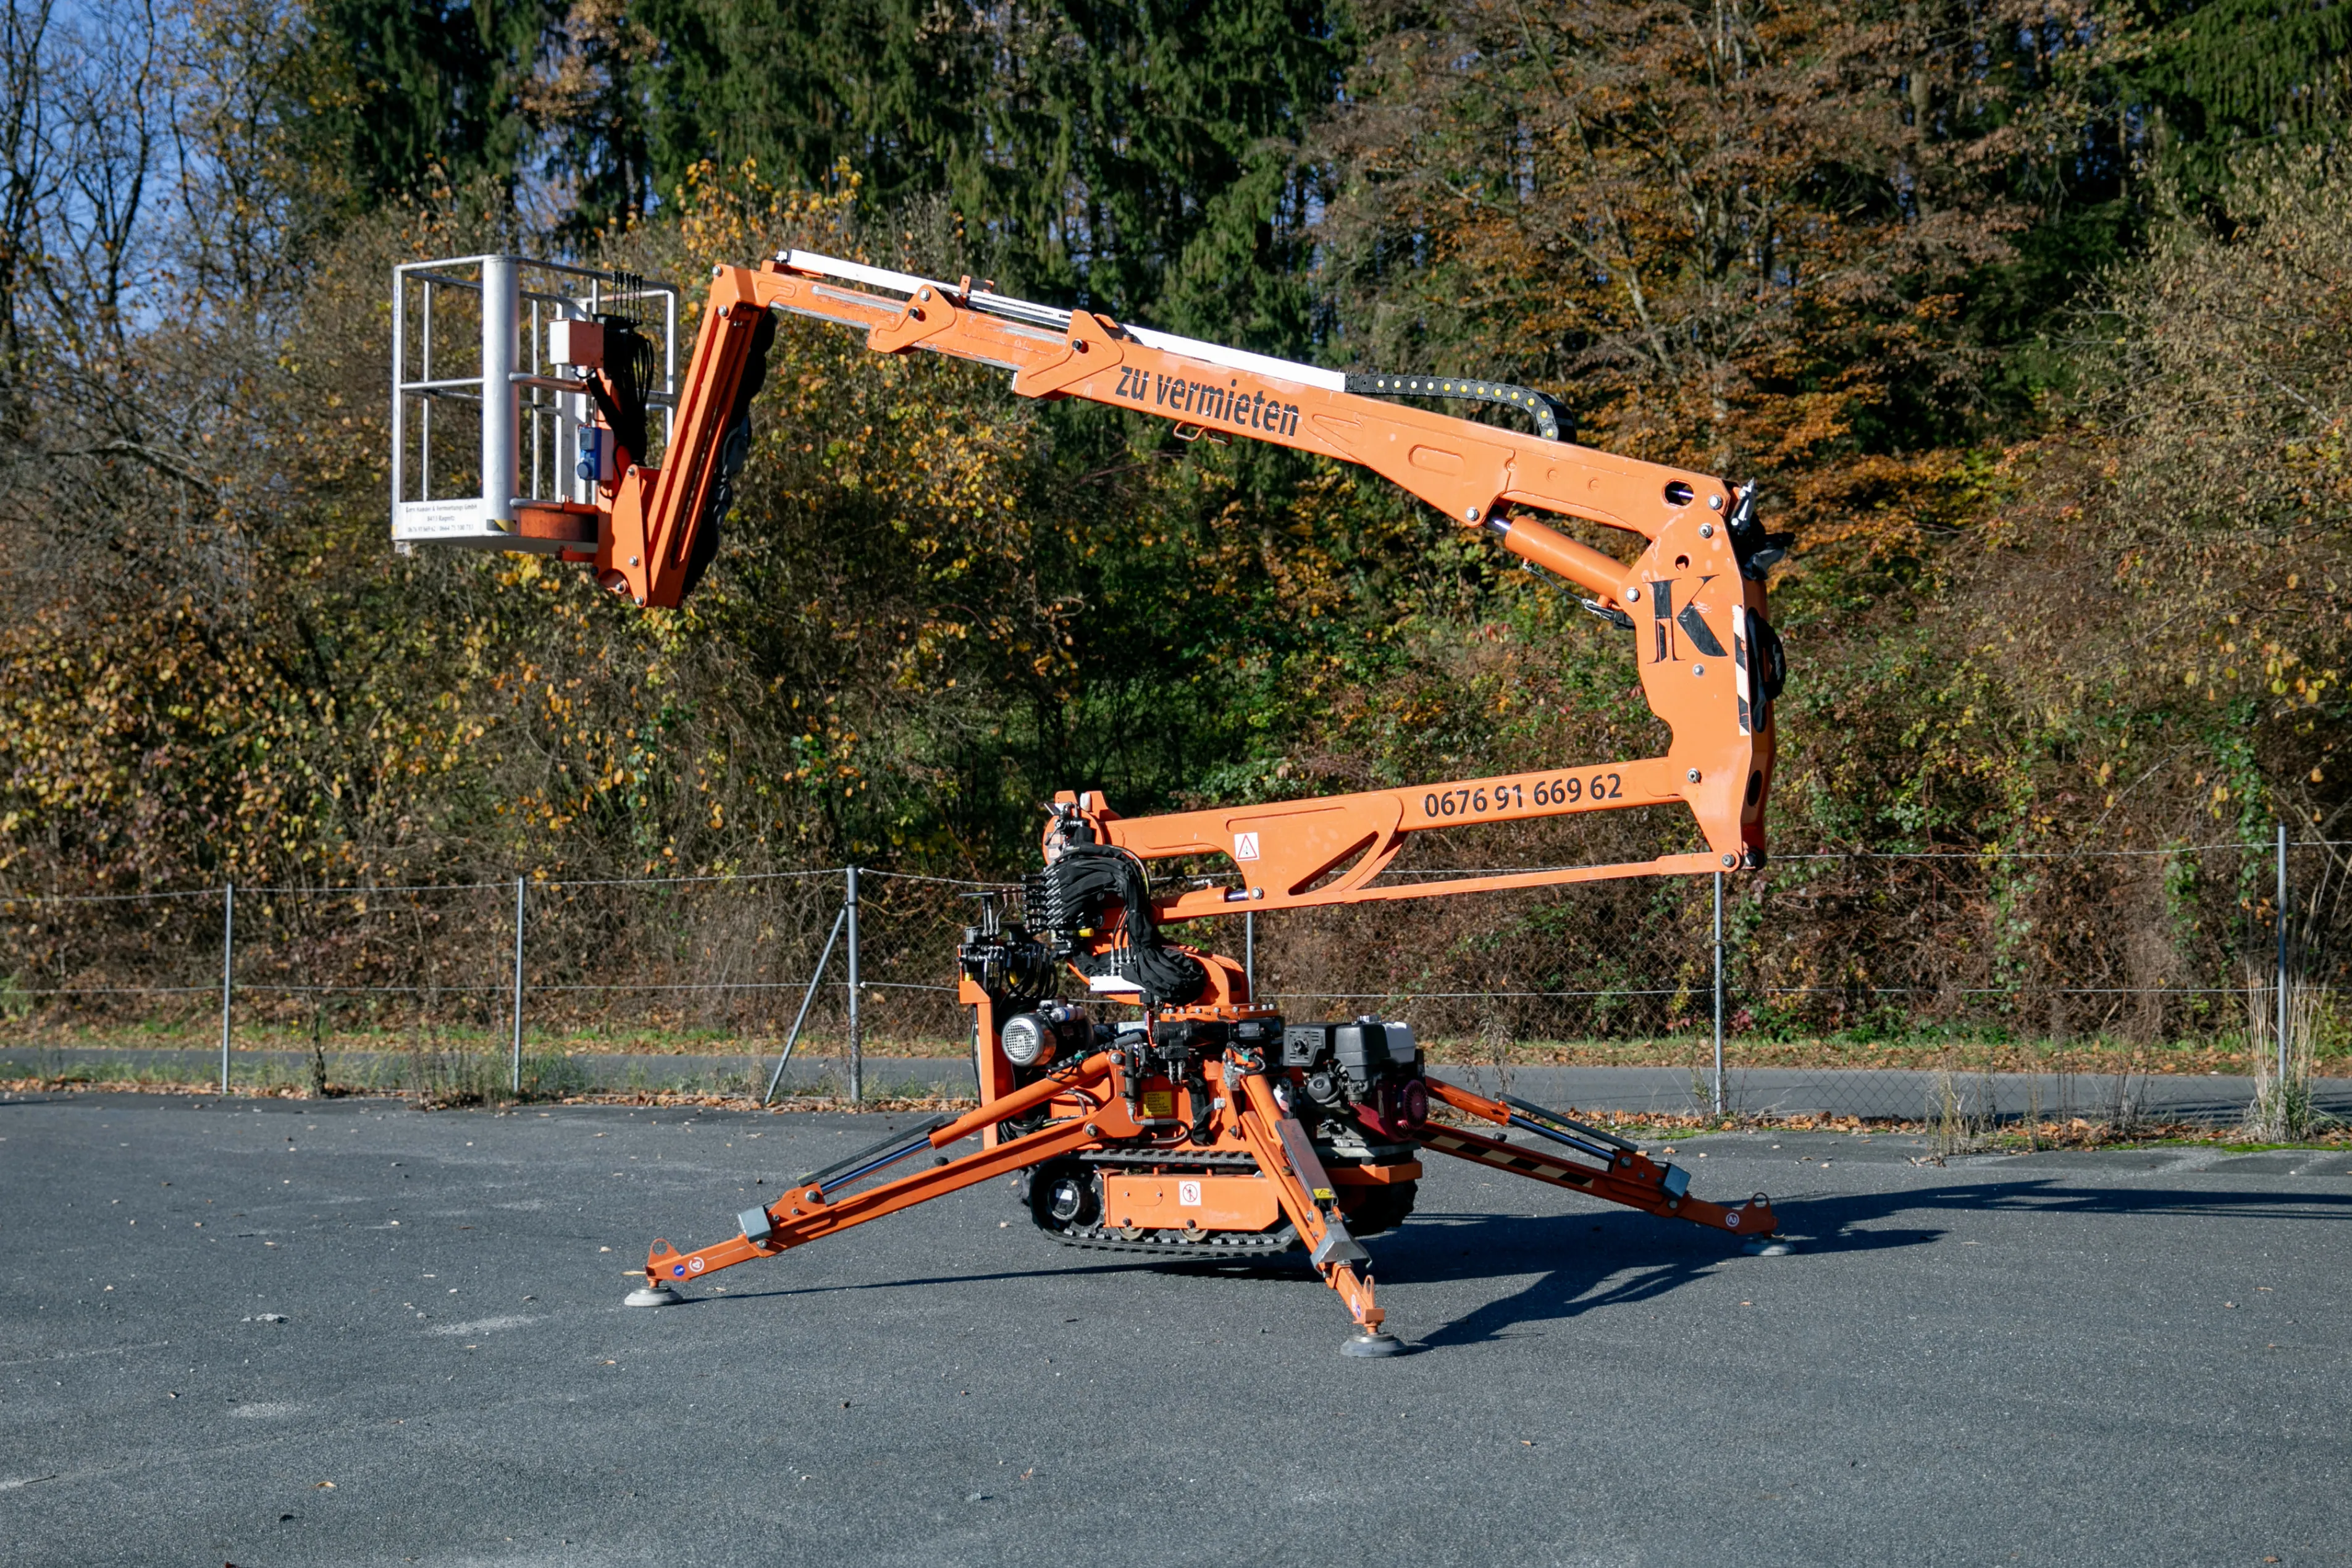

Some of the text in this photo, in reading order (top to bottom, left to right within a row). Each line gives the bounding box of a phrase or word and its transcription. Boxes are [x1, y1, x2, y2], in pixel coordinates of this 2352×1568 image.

[1115, 366, 1299, 437] zu vermieten
[1425, 787, 1487, 818] 0676
[1495, 784, 1522, 811] 91
[1534, 777, 1582, 806] 669
[1590, 773, 1623, 800] 62
